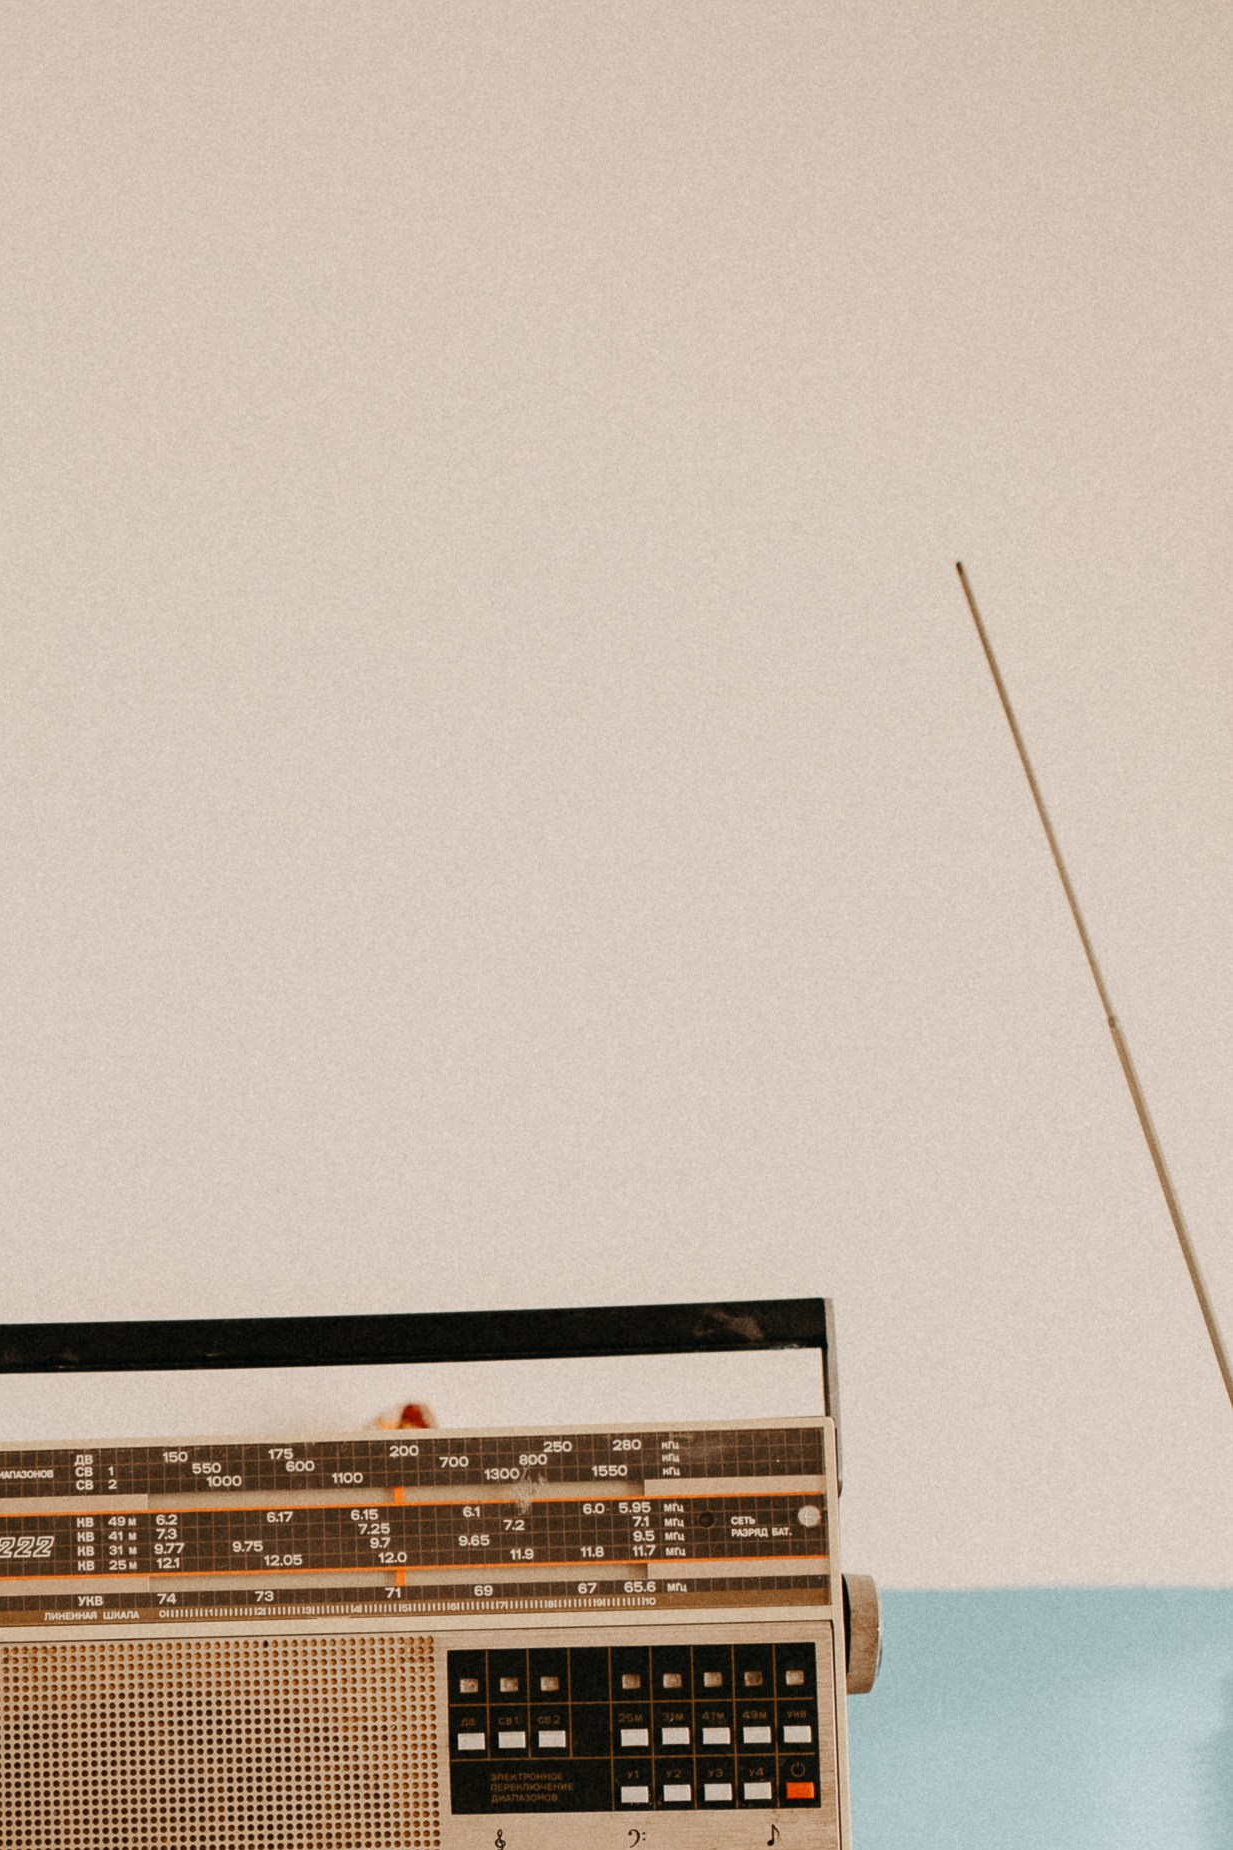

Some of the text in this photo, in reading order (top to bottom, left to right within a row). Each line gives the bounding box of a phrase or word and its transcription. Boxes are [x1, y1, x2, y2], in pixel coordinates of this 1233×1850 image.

[75, 1455, 93, 1466] ДВ
[163, 1452, 188, 1462] 150
[268, 1448, 293, 1460] 175
[390, 1445, 418, 1457] 200
[543, 1441, 572, 1452] 250
[612, 1439, 641, 1451] 280
[76, 1467, 93, 1477] СВ
[108, 1467, 114, 1476] 1
[192, 1463, 221, 1474] 550
[286, 1461, 314, 1472] 600
[440, 1456, 468, 1467] 700
[519, 1454, 547, 1465] 800
[76, 1480, 94, 1490] СВ
[108, 1480, 117, 1489] 2
[207, 1476, 242, 1486] 1000
[332, 1473, 363, 1483] 1100
[484, 1468, 519, 1480] 1300
[592, 1465, 627, 1477] 1550
[77, 1518, 94, 1527] КВ
[108, 1517, 126, 1526] 49
[156, 1514, 177, 1525] 6.2
[267, 1512, 293, 1522] 6.17
[351, 1509, 378, 1520] 6.15
[463, 1506, 480, 1517] 6.1
[583, 1503, 604, 1514] 6.0
[619, 1502, 651, 1513] 5.95
[731, 1516, 755, 1525] СЕТЬ
[77, 1532, 94, 1542] КВ
[108, 1531, 125, 1540] 41
[157, 1528, 177, 1539] 7.3
[358, 1523, 390, 1534] 7.25
[503, 1519, 524, 1530] 7.2
[633, 1516, 649, 1527] 7.1
[732, 1527, 791, 1537] РАЗРЯД БАТ.
[78, 1546, 94, 1556] КВ
[109, 1545, 124, 1555] 31
[154, 1542, 184, 1554] 9.77
[233, 1541, 263, 1552] 9.75
[370, 1537, 390, 1548] 9.7
[459, 1535, 489, 1546] 9.65
[633, 1530, 654, 1541] 9.5
[78, 1561, 94, 1570] КВ
[109, 1560, 126, 1570] 25
[157, 1558, 180, 1568] 12.1
[264, 1554, 302, 1566] 12.05
[378, 1552, 407, 1563] 12.0
[510, 1548, 533, 1559] 11.9
[581, 1546, 604, 1557] 11.8
[633, 1545, 656, 1556] 11.7
[78, 1596, 103, 1606] УКВ
[158, 1593, 176, 1604] 74
[255, 1590, 274, 1602] 73
[385, 1587, 401, 1598] 71
[474, 1585, 493, 1597] 69
[578, 1583, 597, 1594] 67
[624, 1582, 656, 1593] 65.6
[104, 1611, 139, 1619] ШКАЛА
[159, 1610, 166, 1618] 0
[646, 1597, 656, 1606] 10
